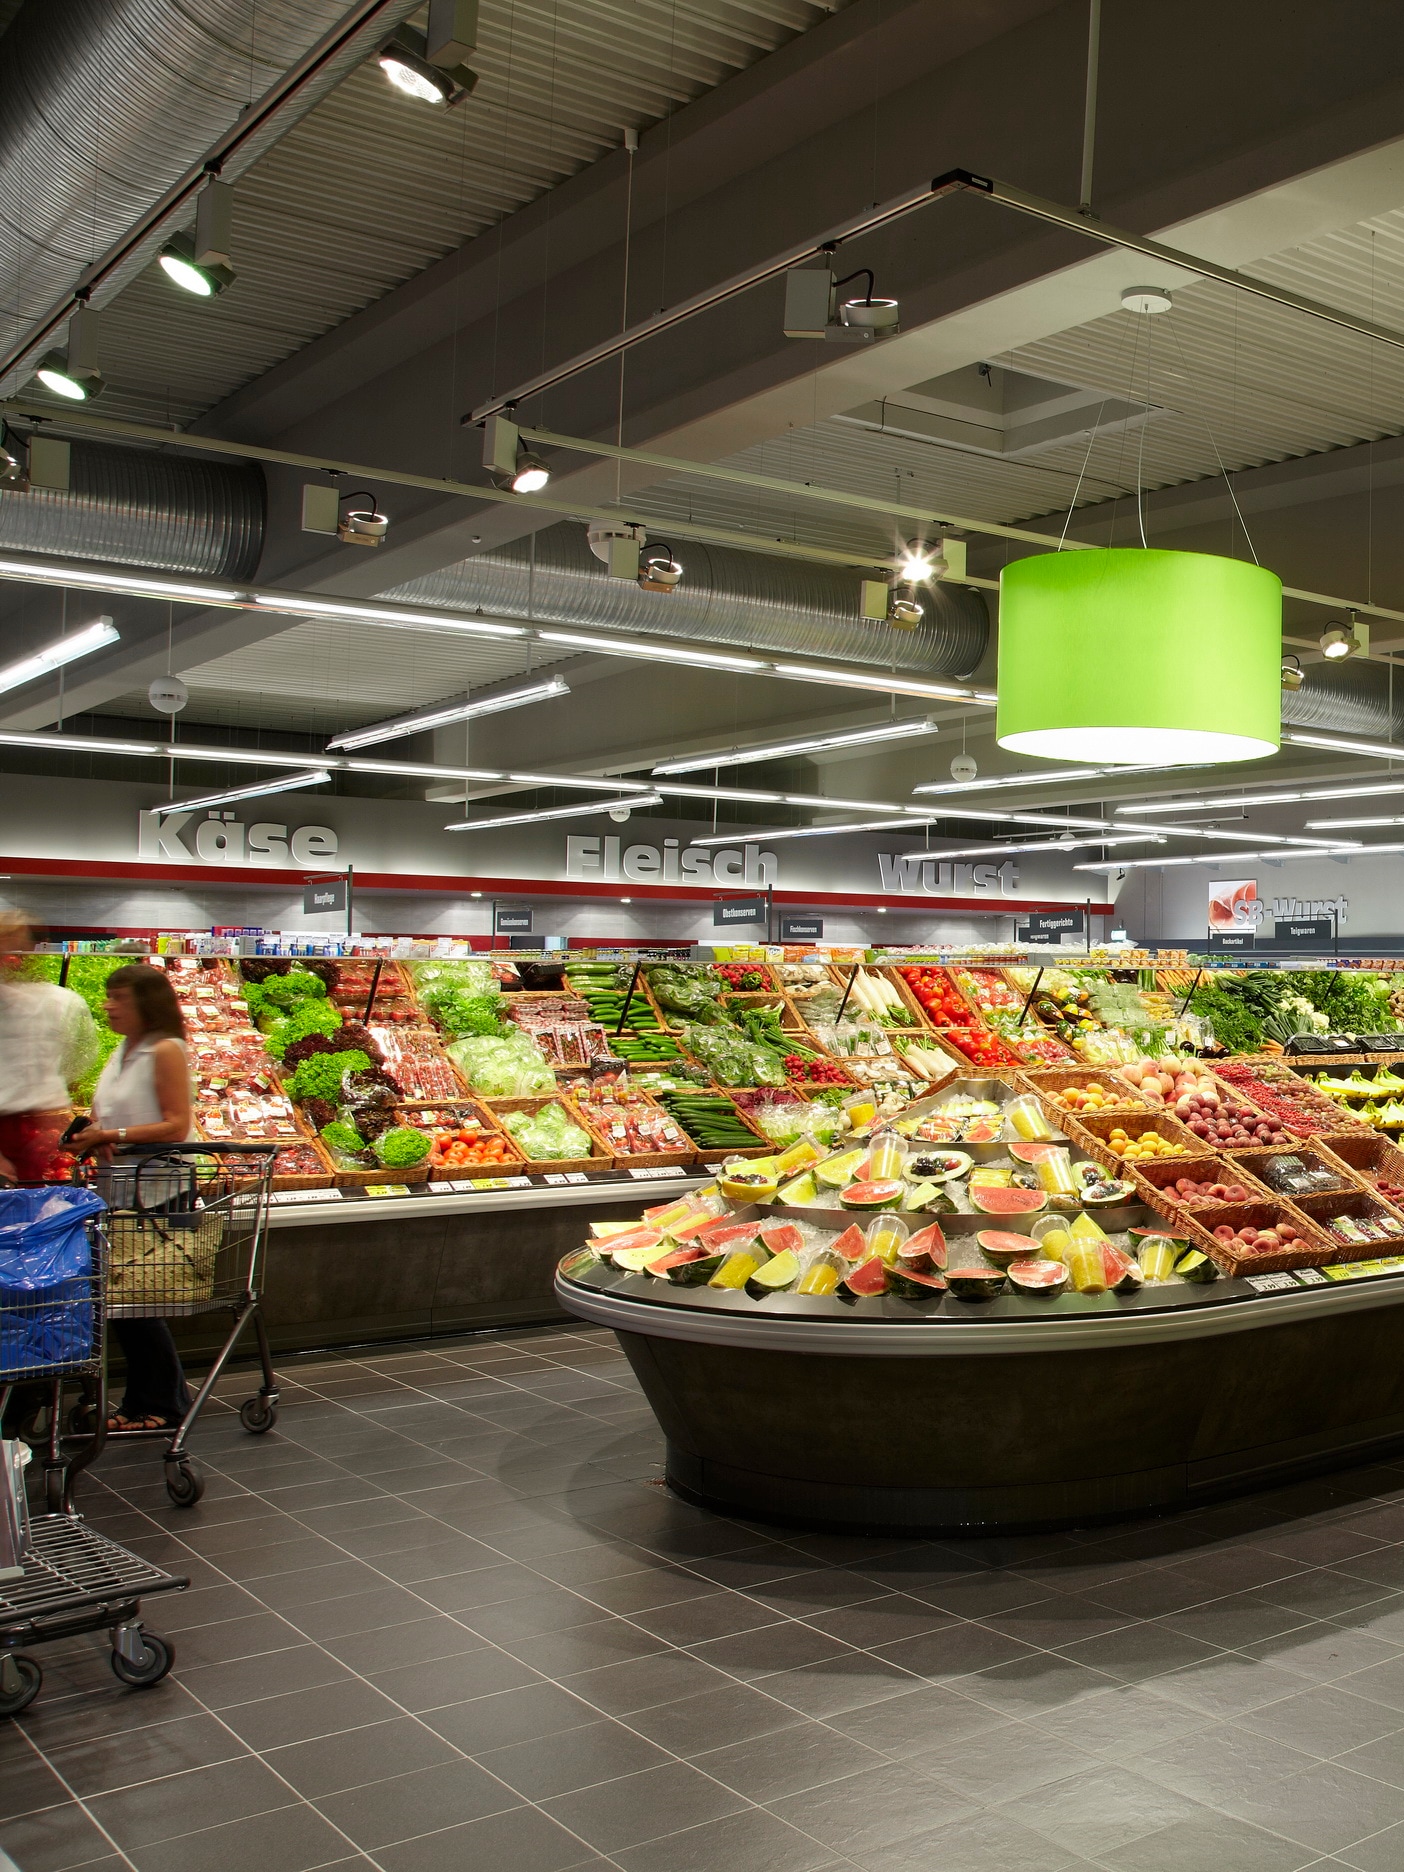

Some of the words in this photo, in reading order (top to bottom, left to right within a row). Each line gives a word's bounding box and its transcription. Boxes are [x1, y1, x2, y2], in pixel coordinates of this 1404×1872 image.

[138, 809, 339, 867] Käse
[566, 835, 778, 885] Fleisch
[878, 853, 1020, 897] Wurst
[722, 907, 757, 919] Obstkonserven
[1039, 917, 1074, 929] Fertiggerichte
[1233, 895, 1348, 926] SB-Wurst
[1290, 926, 1316, 937] Teigwaren
